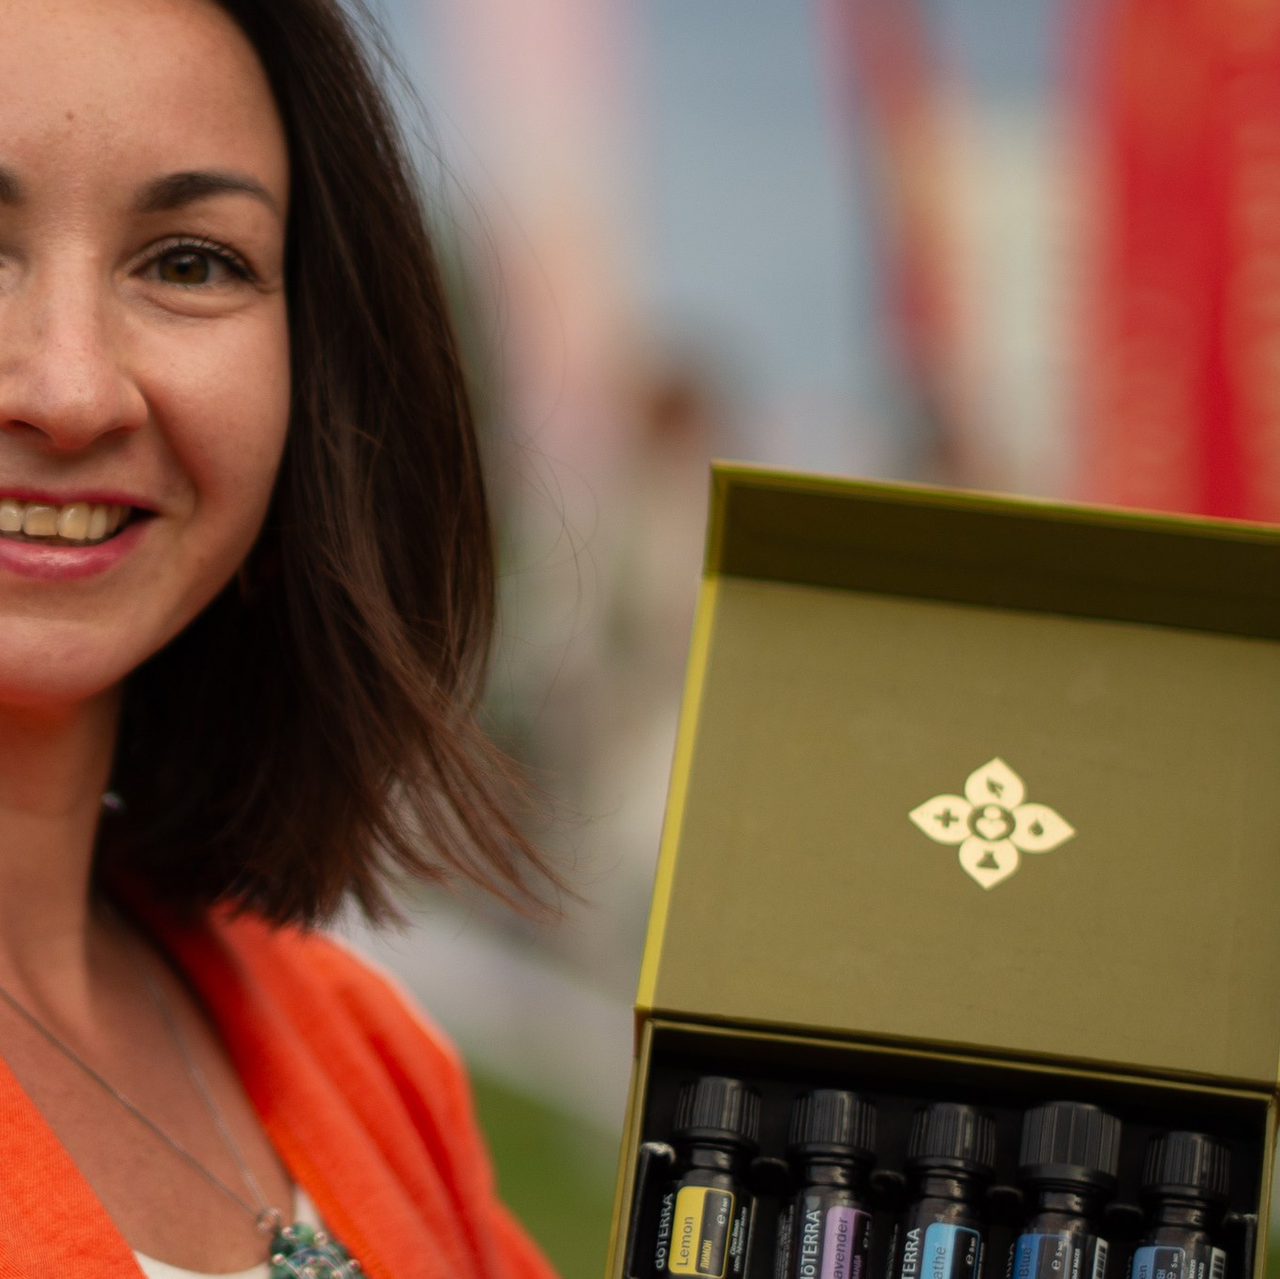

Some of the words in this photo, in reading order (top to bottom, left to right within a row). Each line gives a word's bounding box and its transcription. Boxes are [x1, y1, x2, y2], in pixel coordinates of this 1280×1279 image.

[677, 1217, 694, 1267] Lemon
[700, 1240, 713, 1269] ЛИМОН
[1018, 1247, 1032, 1277] Blue
